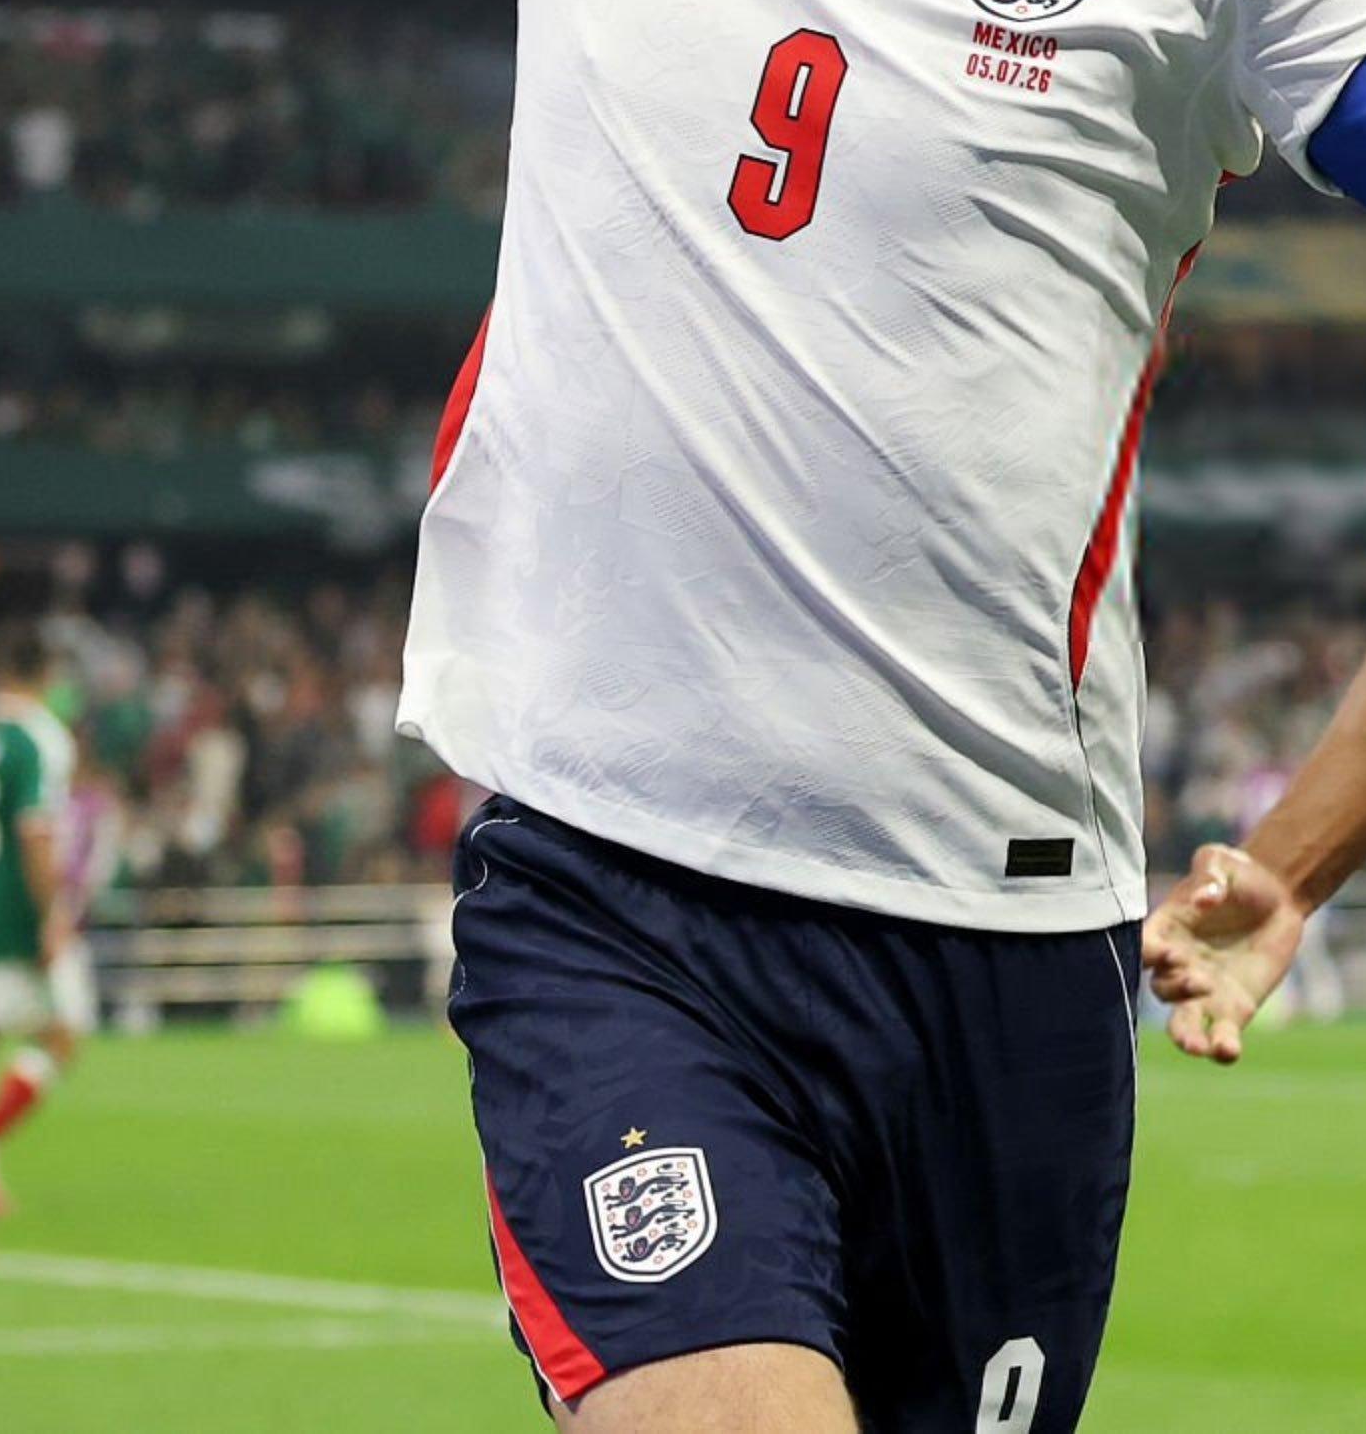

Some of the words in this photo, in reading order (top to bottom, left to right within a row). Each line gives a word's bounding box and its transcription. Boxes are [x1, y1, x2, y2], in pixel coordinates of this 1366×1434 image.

[972, 21, 1058, 60] MEXICO
[965, 53, 1052, 93] 05.07.26
[727, 27, 848, 241] 9
